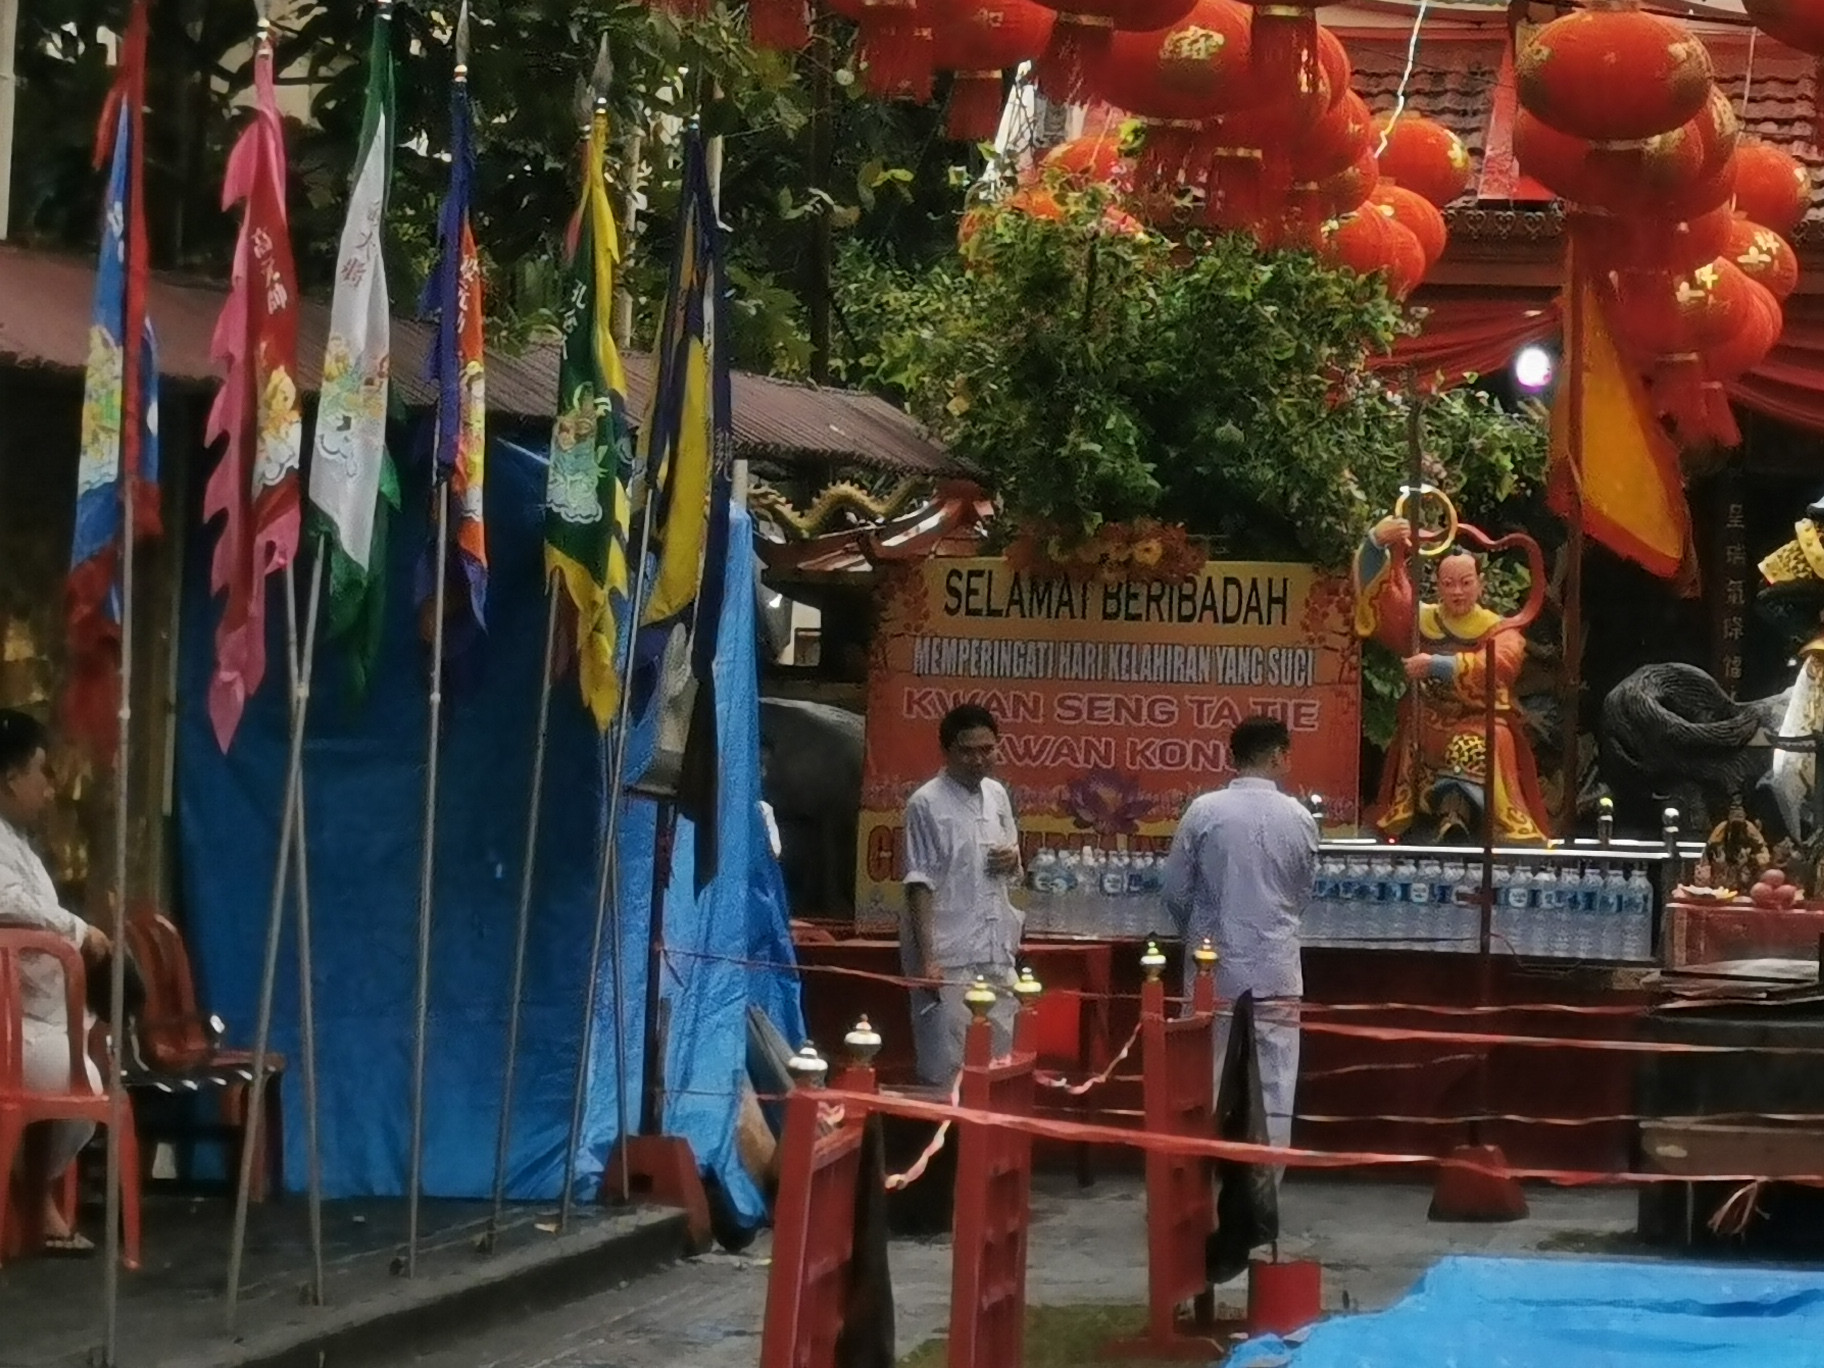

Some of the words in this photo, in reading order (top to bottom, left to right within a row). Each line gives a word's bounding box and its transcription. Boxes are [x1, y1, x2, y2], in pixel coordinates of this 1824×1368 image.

[1102, 576, 1288, 625] BERIBADAH
[914, 636, 1053, 678] MEMPERINGATI
[1057, 641, 1102, 680] HARI
[1107, 643, 1210, 683] KELAHIRAN
[1215, 646, 1263, 686] YANG
[1266, 648, 1314, 687] SUCI
[1055, 692, 1178, 727] SENG
[1184, 695, 1242, 729] TA
[1126, 737, 1238, 773] KON
